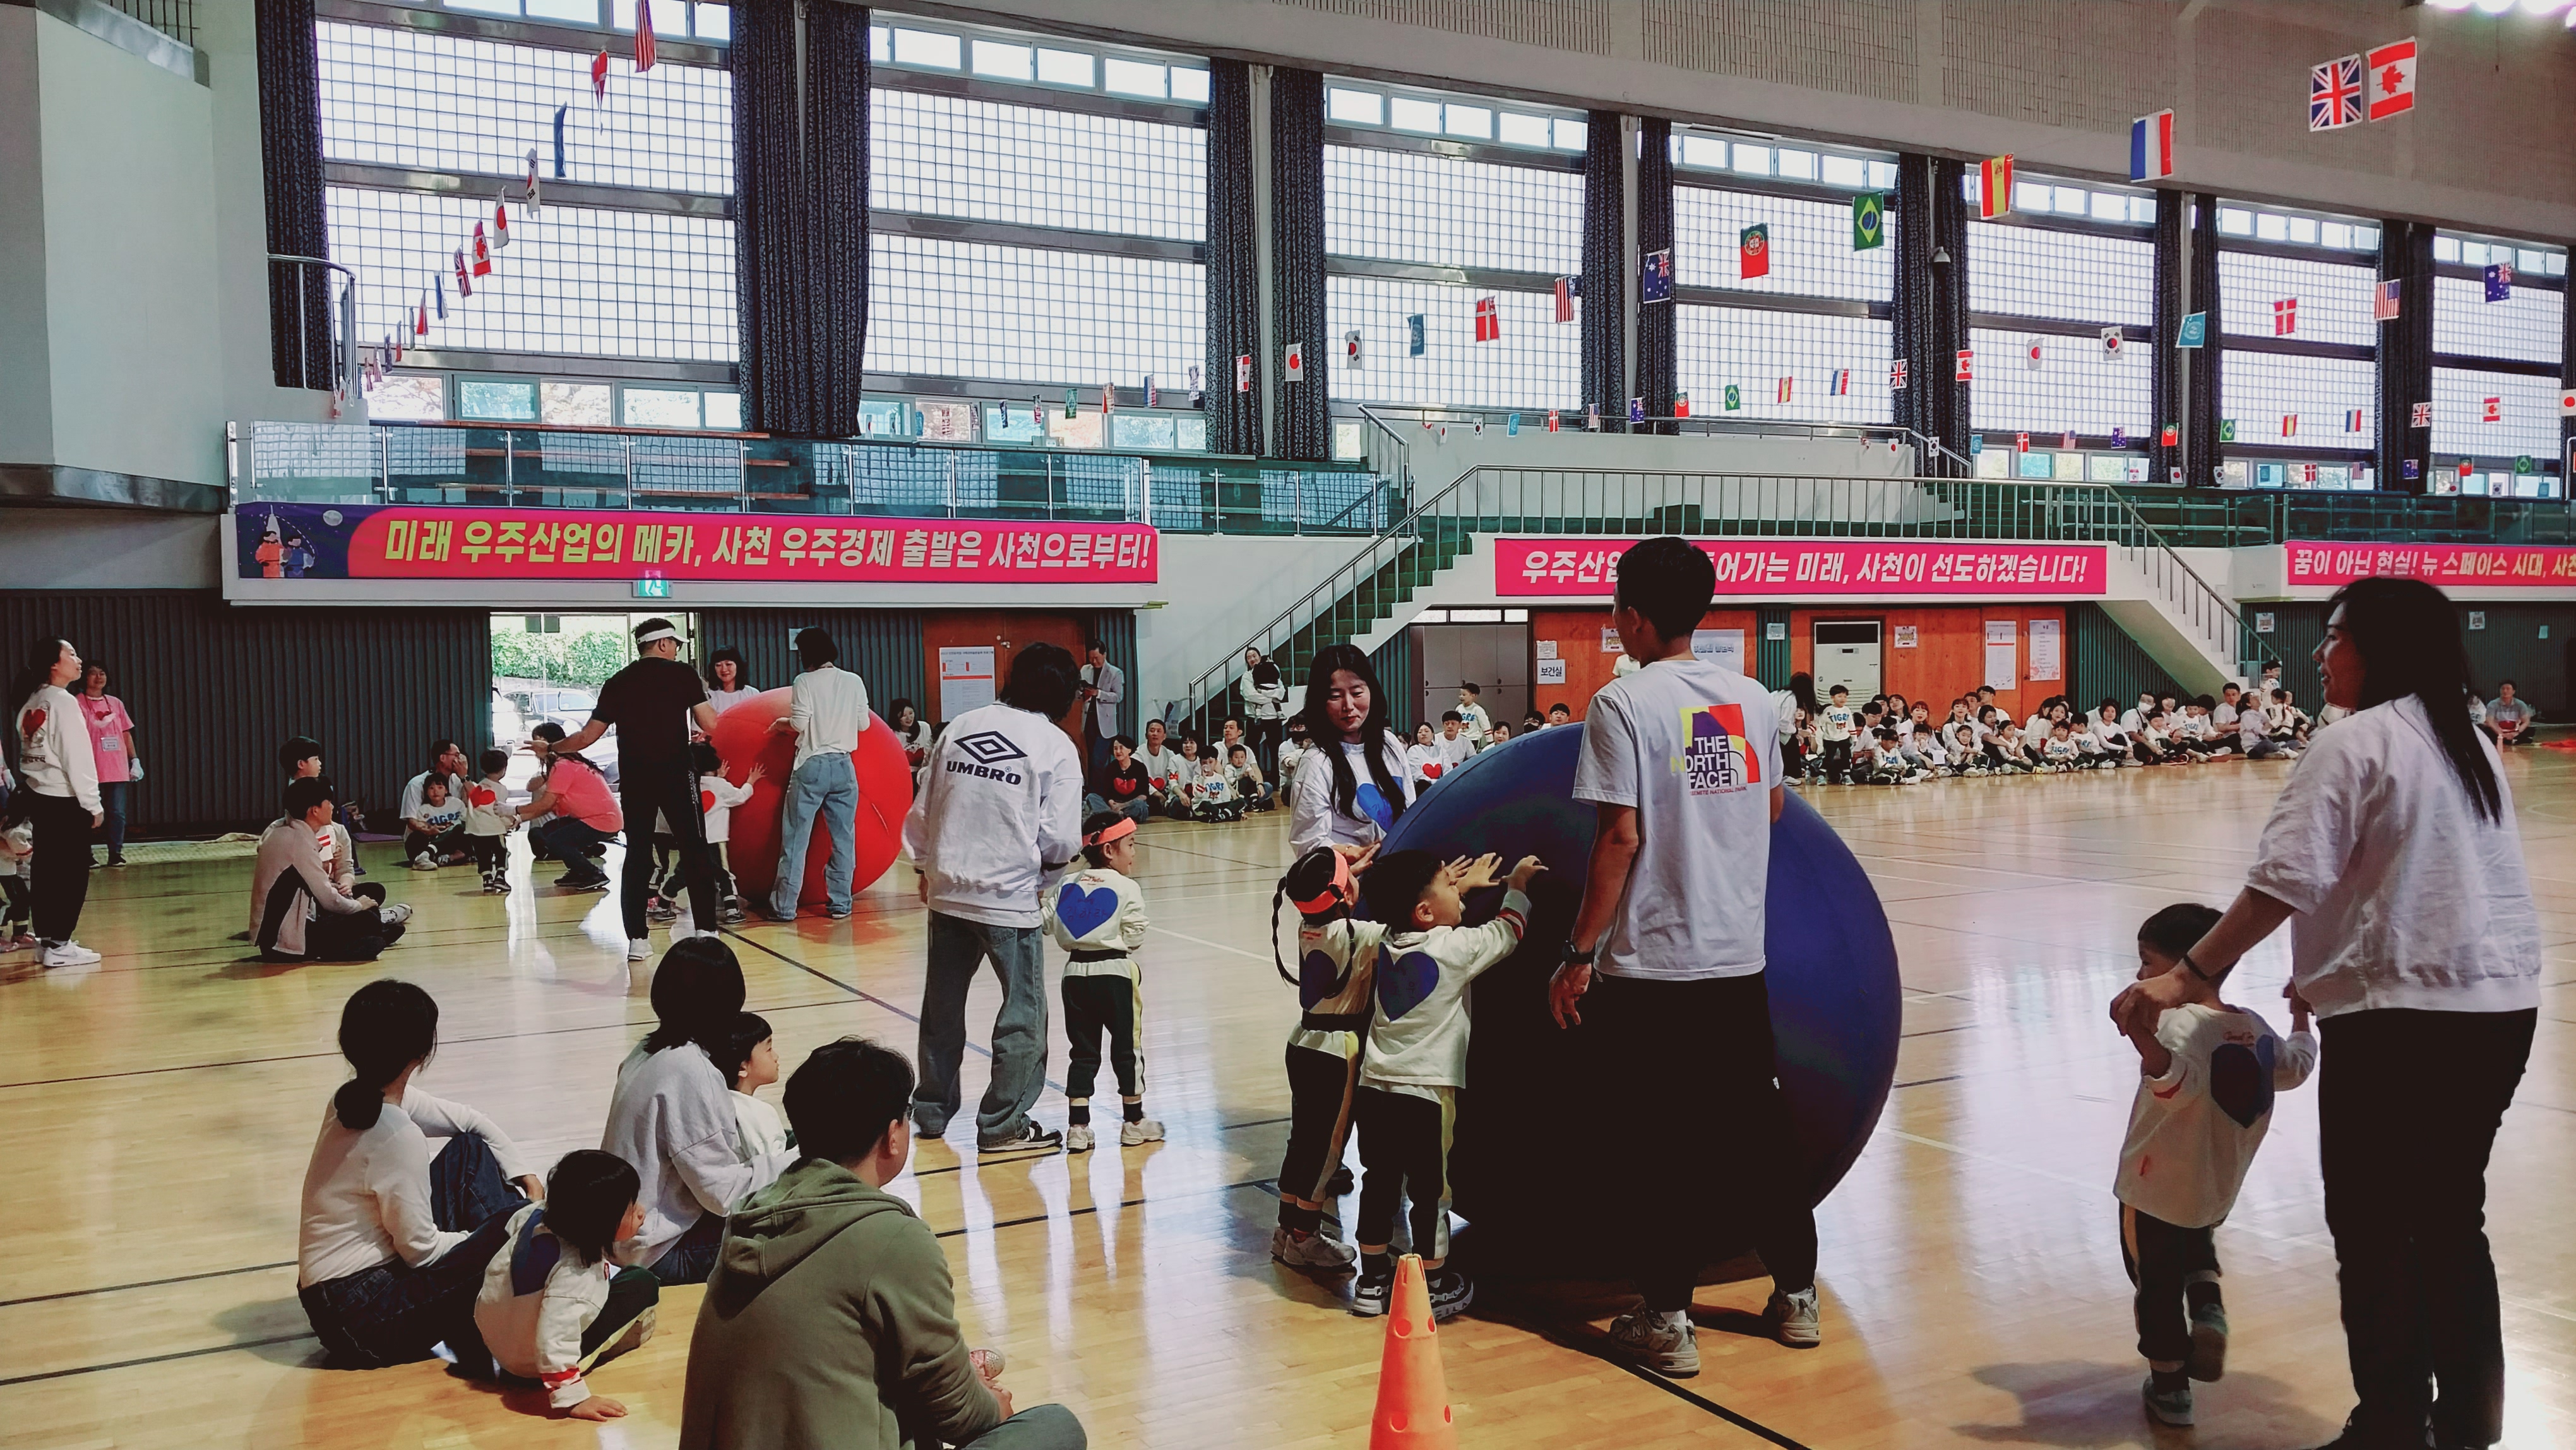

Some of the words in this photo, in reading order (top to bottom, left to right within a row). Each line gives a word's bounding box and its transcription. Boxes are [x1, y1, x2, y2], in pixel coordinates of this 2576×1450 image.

[385, 520, 453, 562] 미래
[460, 522, 624, 563] 우주산업의
[632, 524, 701, 567] 메카,
[712, 526, 770, 566] 사천
[779, 527, 896, 567] 우주경제
[903, 530, 981, 568] 출발은
[988, 532, 1152, 569] 사천으로부터!
[1796, 552, 1849, 584] 미래,
[1856, 553, 1926, 582] 사천이
[1930, 554, 2088, 584] 선도하겠습니다!
[2294, 549, 2332, 575] 꿈이
[2335, 550, 2372, 575] 아닌
[2376, 550, 2418, 576] 현실!
[2421, 552, 2438, 576] 뉴
[2442, 551, 2508, 577] 스페이스
[2512, 553, 2546, 578] 시대,
[1541, 666, 1563, 677] 보건실
[1695, 736, 1728, 753] THE
[947, 760, 1022, 786] UMBRO
[1671, 753, 1729, 772] NORTH
[1688, 770, 1730, 789] FACE
